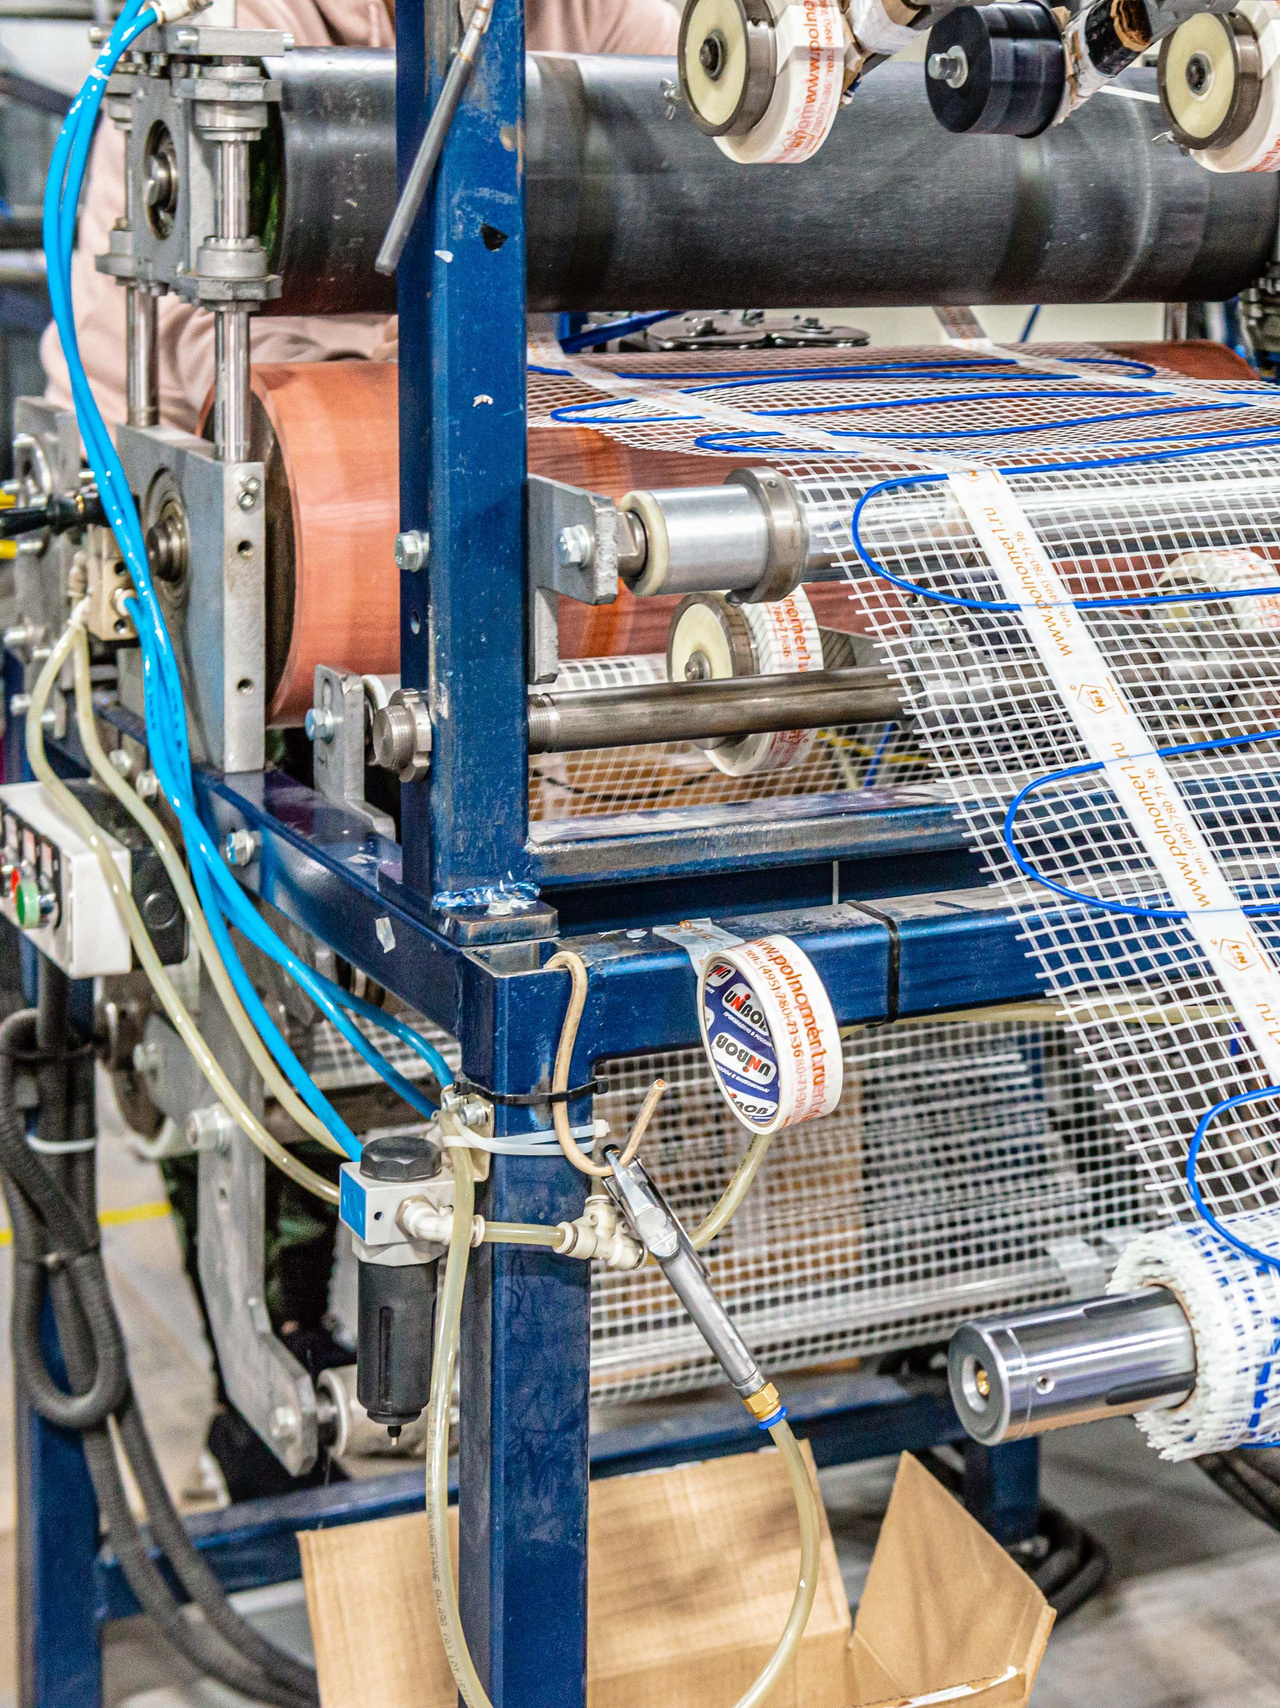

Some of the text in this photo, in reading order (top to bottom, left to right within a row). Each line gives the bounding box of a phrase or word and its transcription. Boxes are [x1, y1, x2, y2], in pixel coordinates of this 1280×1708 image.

[783, 594, 811, 672] lnomer1.
[982, 507, 1073, 656] www.polnomer1.ru
[1110, 742, 1211, 907] www.polnomer1.ru
